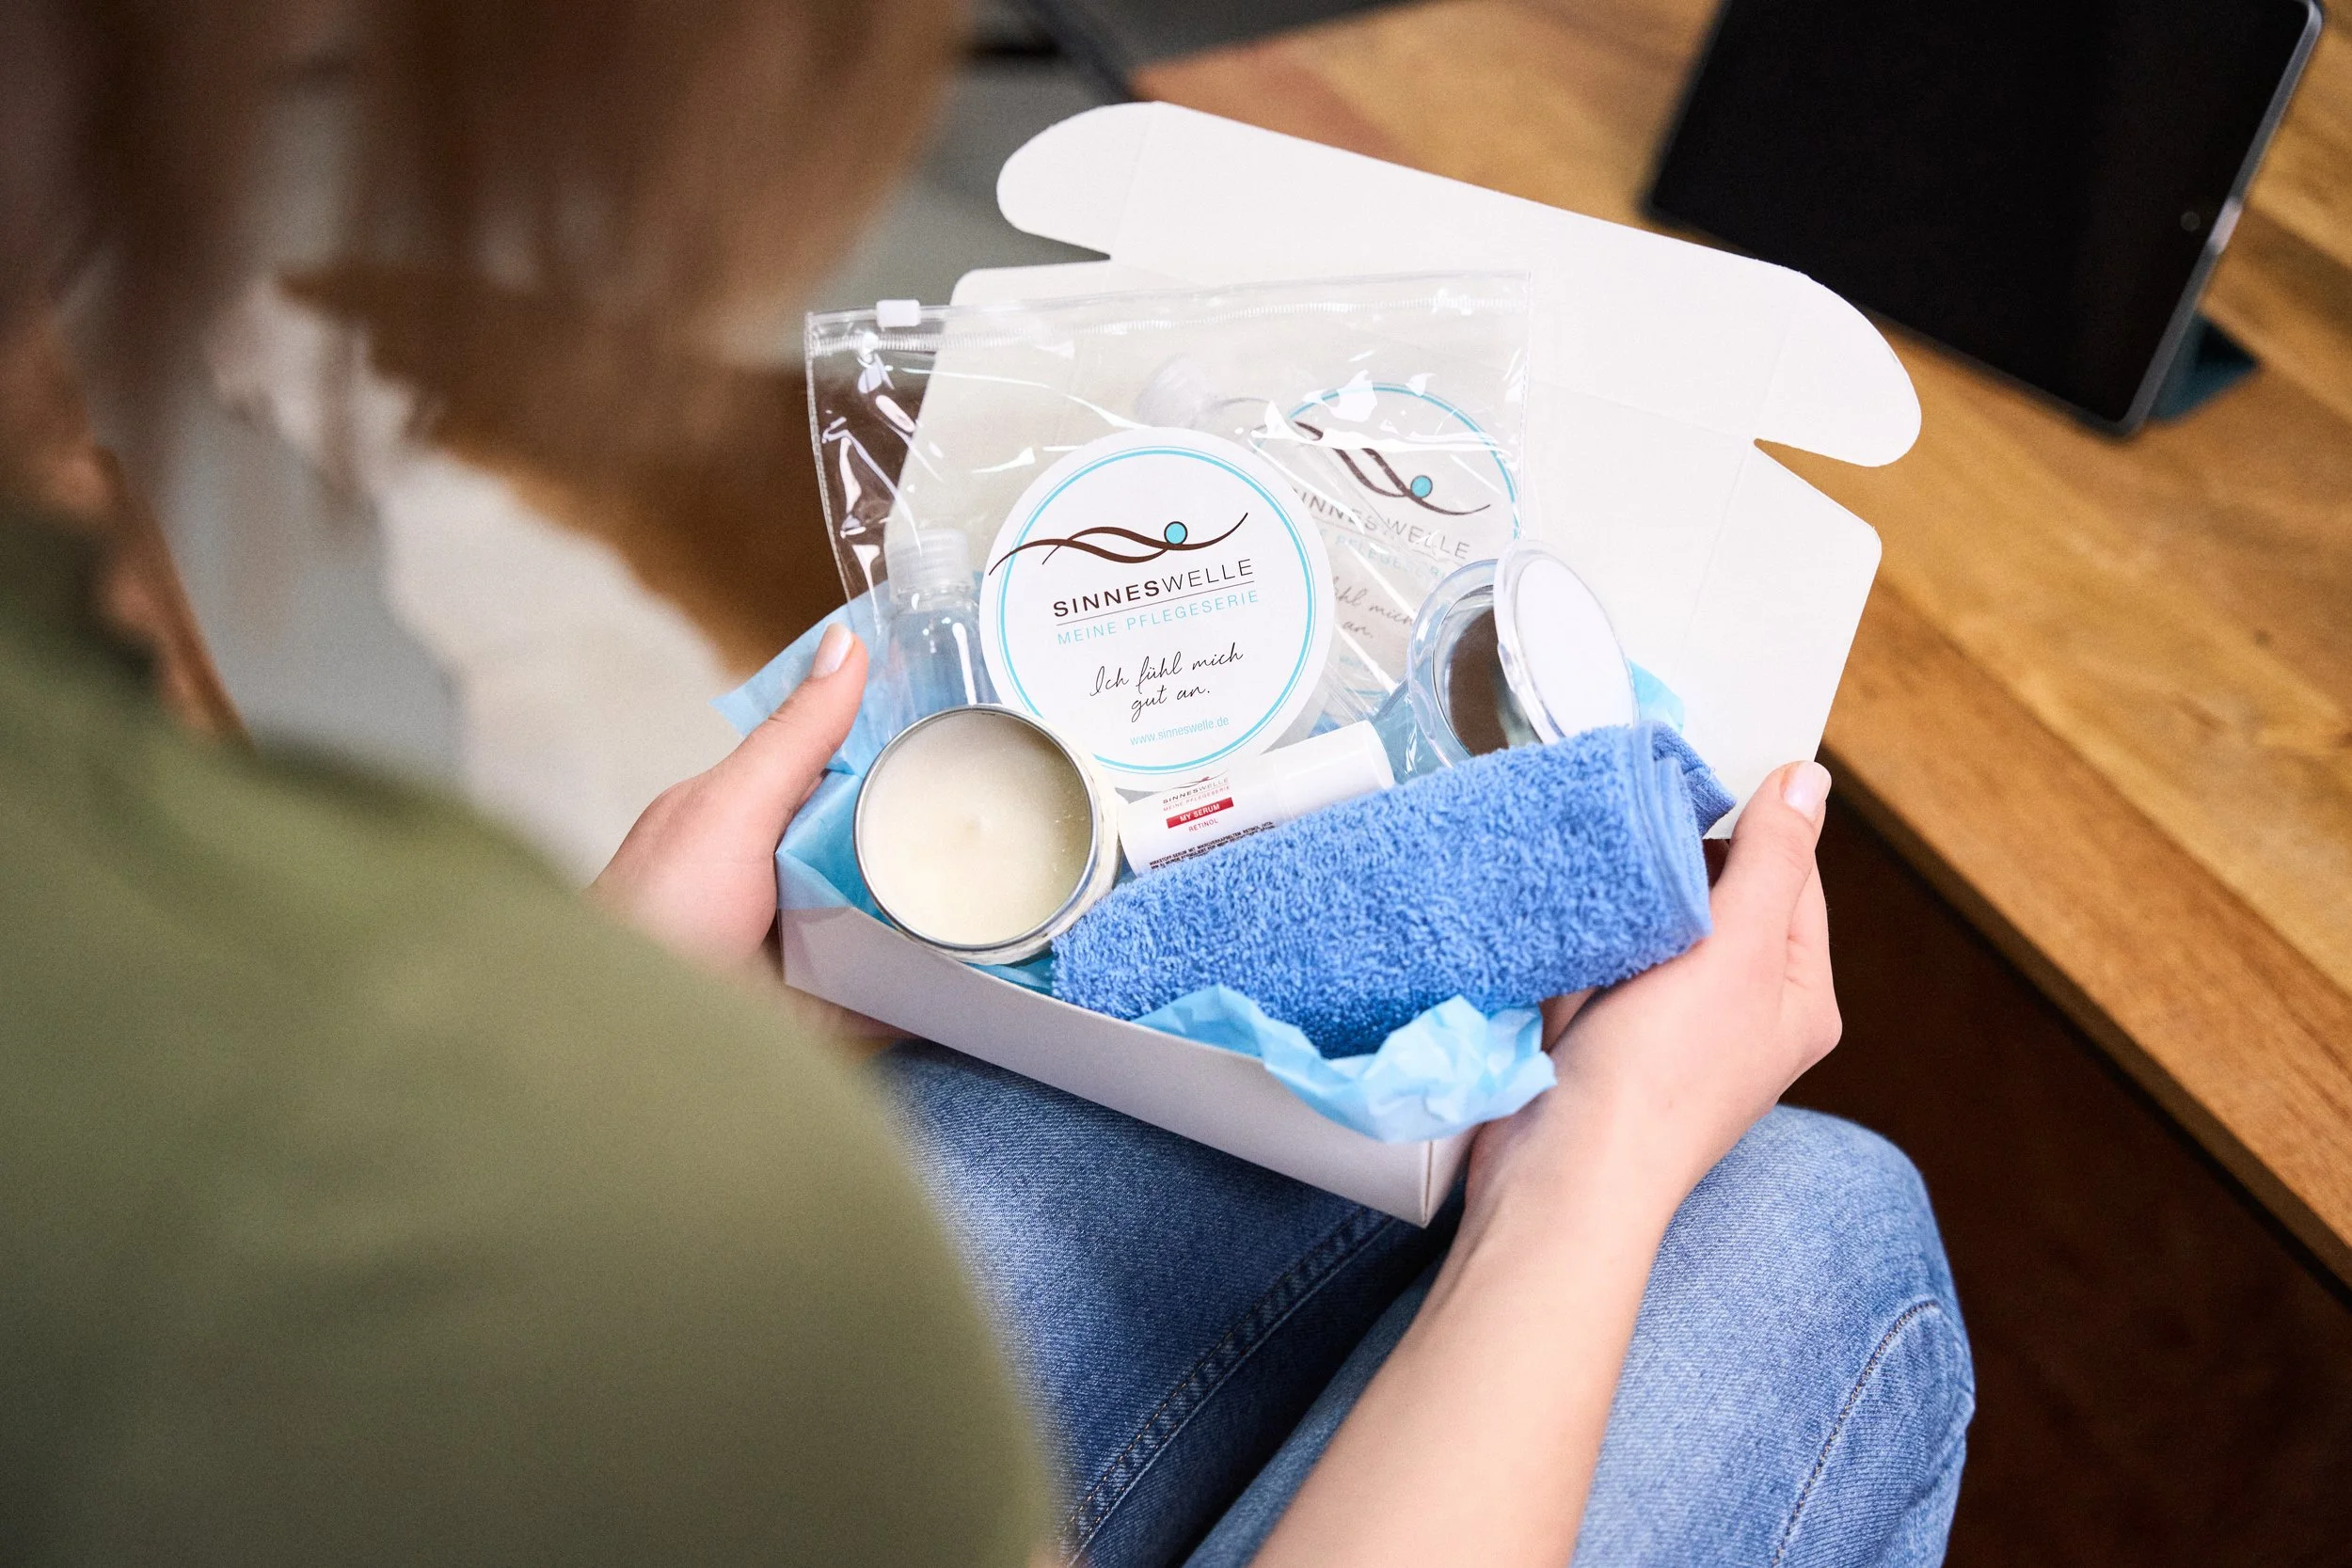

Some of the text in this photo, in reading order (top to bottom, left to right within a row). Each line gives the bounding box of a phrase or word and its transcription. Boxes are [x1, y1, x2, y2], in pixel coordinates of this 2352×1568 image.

[1293, 486, 1470, 560] INNESWELLE
[1053, 559, 1254, 617] SINNESWELLE
[1057, 590, 1260, 645] MEINE PFLEGESERIE
[1089, 641, 1244, 697] Ich fühl mich
[1131, 685, 1212, 723] gut an.
[1130, 715, 1231, 746] www.sinneswelle.de
[1163, 778, 1229, 804] SINNESWELLE
[1180, 803, 1221, 823] MY SERUM
[1188, 817, 1219, 832] RETINOL
